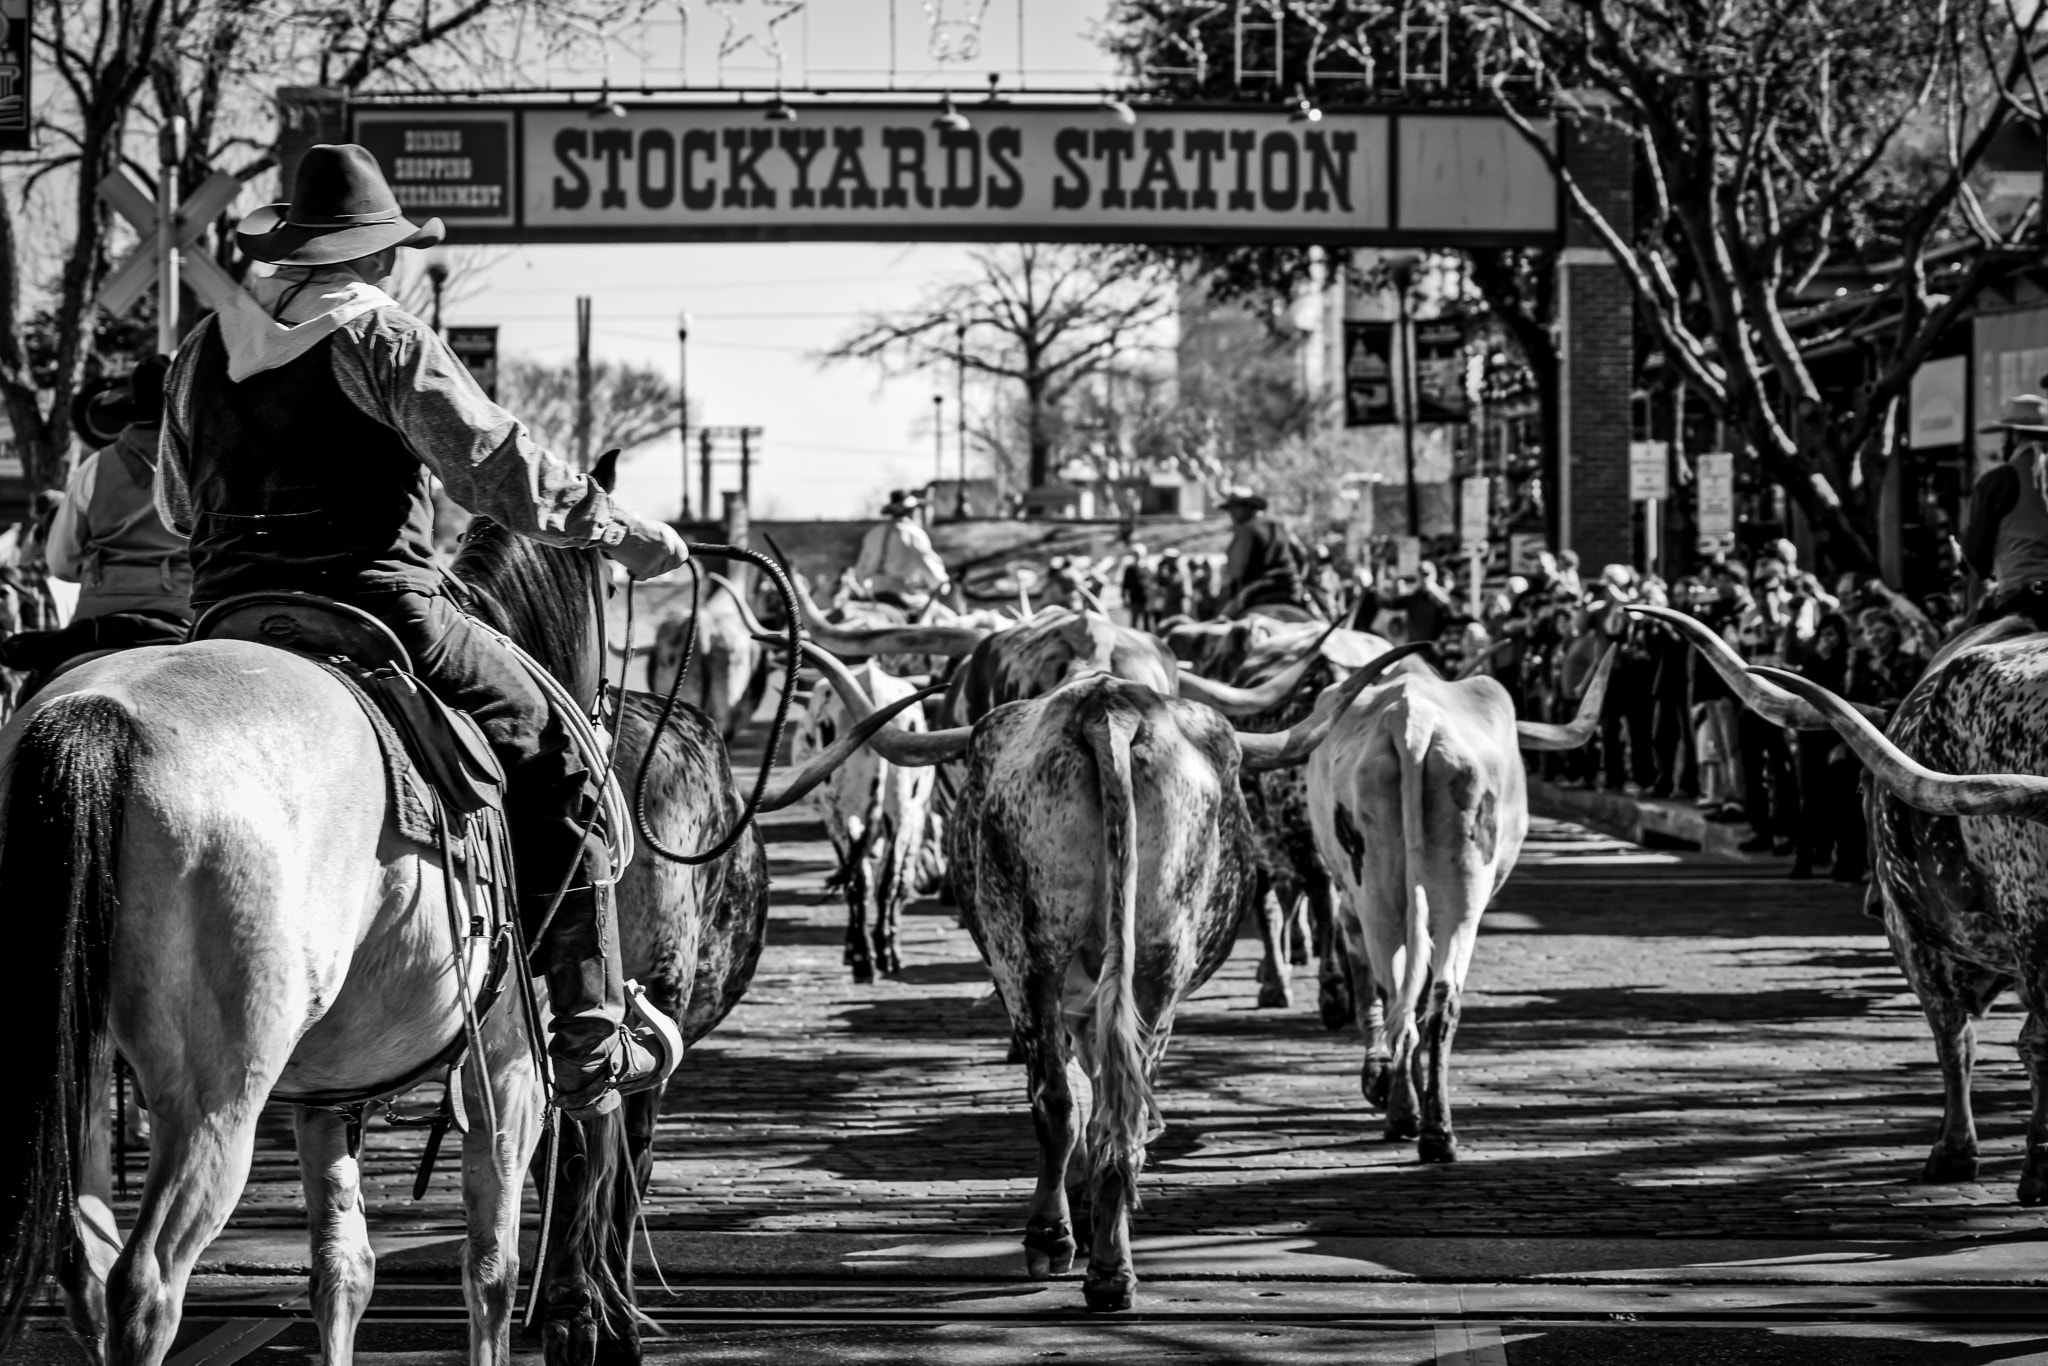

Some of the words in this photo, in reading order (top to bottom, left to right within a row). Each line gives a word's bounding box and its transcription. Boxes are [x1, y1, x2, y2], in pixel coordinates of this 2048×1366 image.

[394, 157, 473, 180] SHOPPING
[552, 127, 1025, 210] STOCKYARDS
[1052, 127, 1358, 212] STATION
[390, 184, 502, 208] ERTAINMENT
